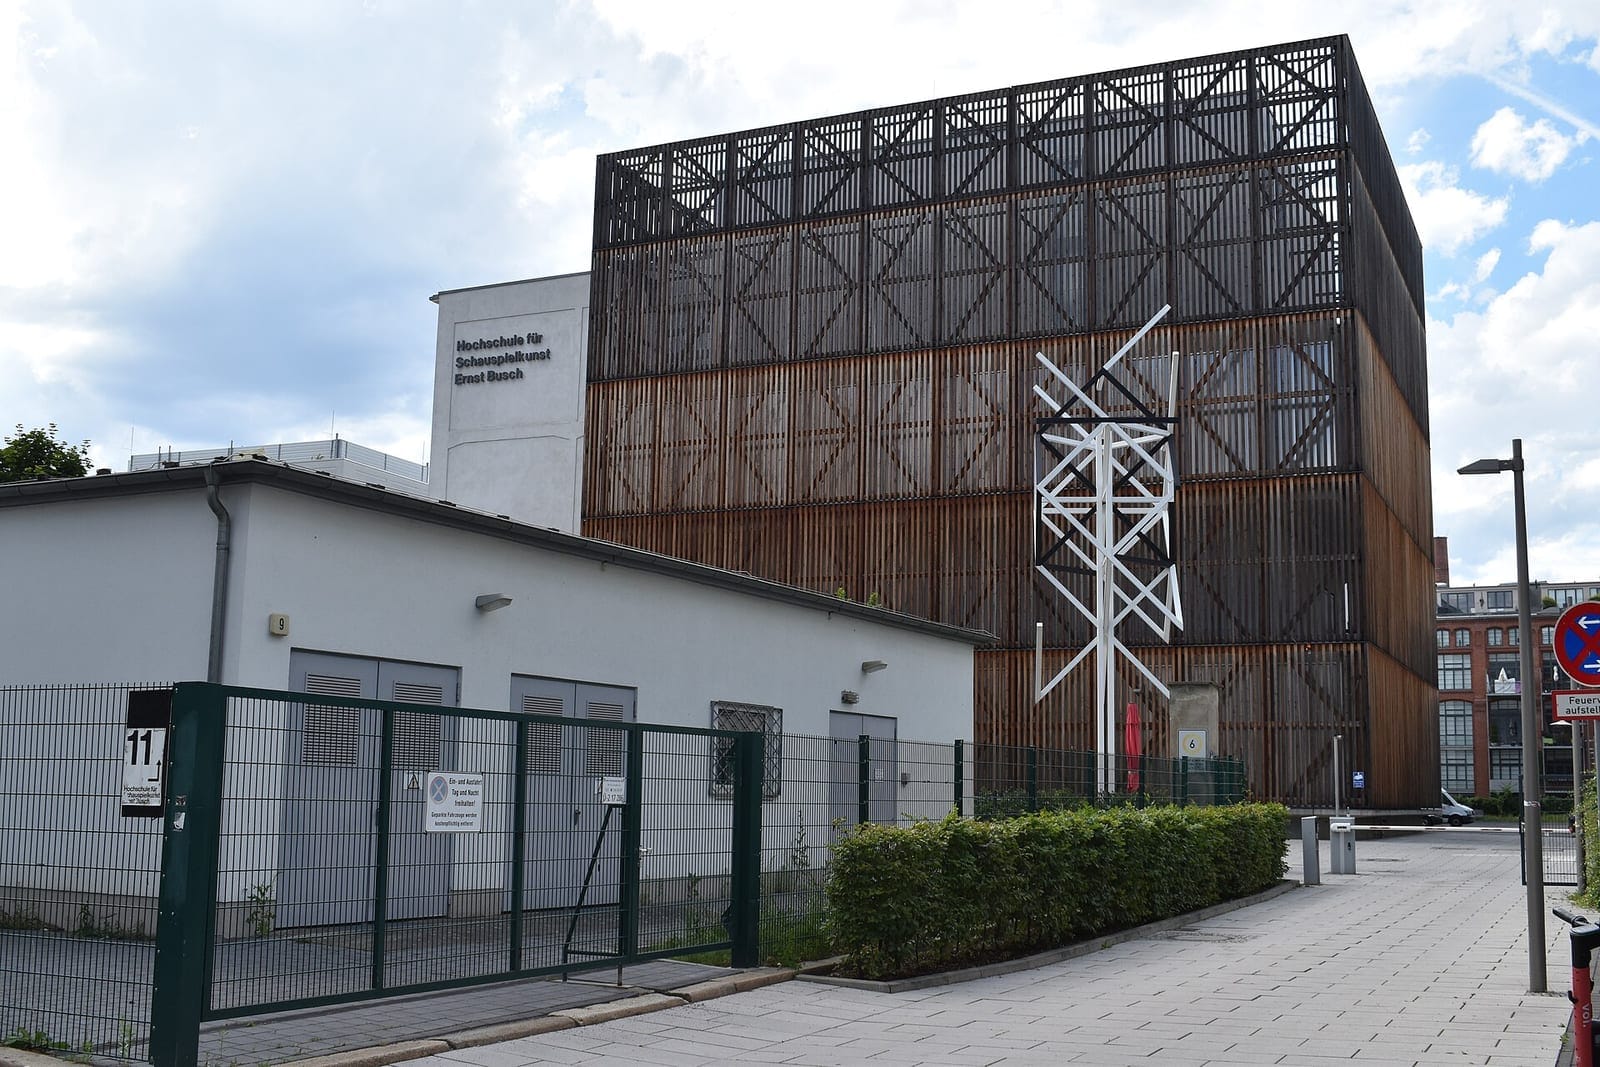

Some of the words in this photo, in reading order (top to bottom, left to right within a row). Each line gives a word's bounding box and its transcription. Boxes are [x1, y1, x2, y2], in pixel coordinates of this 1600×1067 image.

[456, 334, 525, 352] Hochschule
[526, 332, 543, 345] für
[455, 348, 551, 369] Schauspielkunst
[454, 371, 485, 386] Ernst
[486, 367, 524, 382] Busch
[279, 617, 285, 630] 9
[127, 730, 152, 765] 11
[1189, 739, 1195, 749] 6
